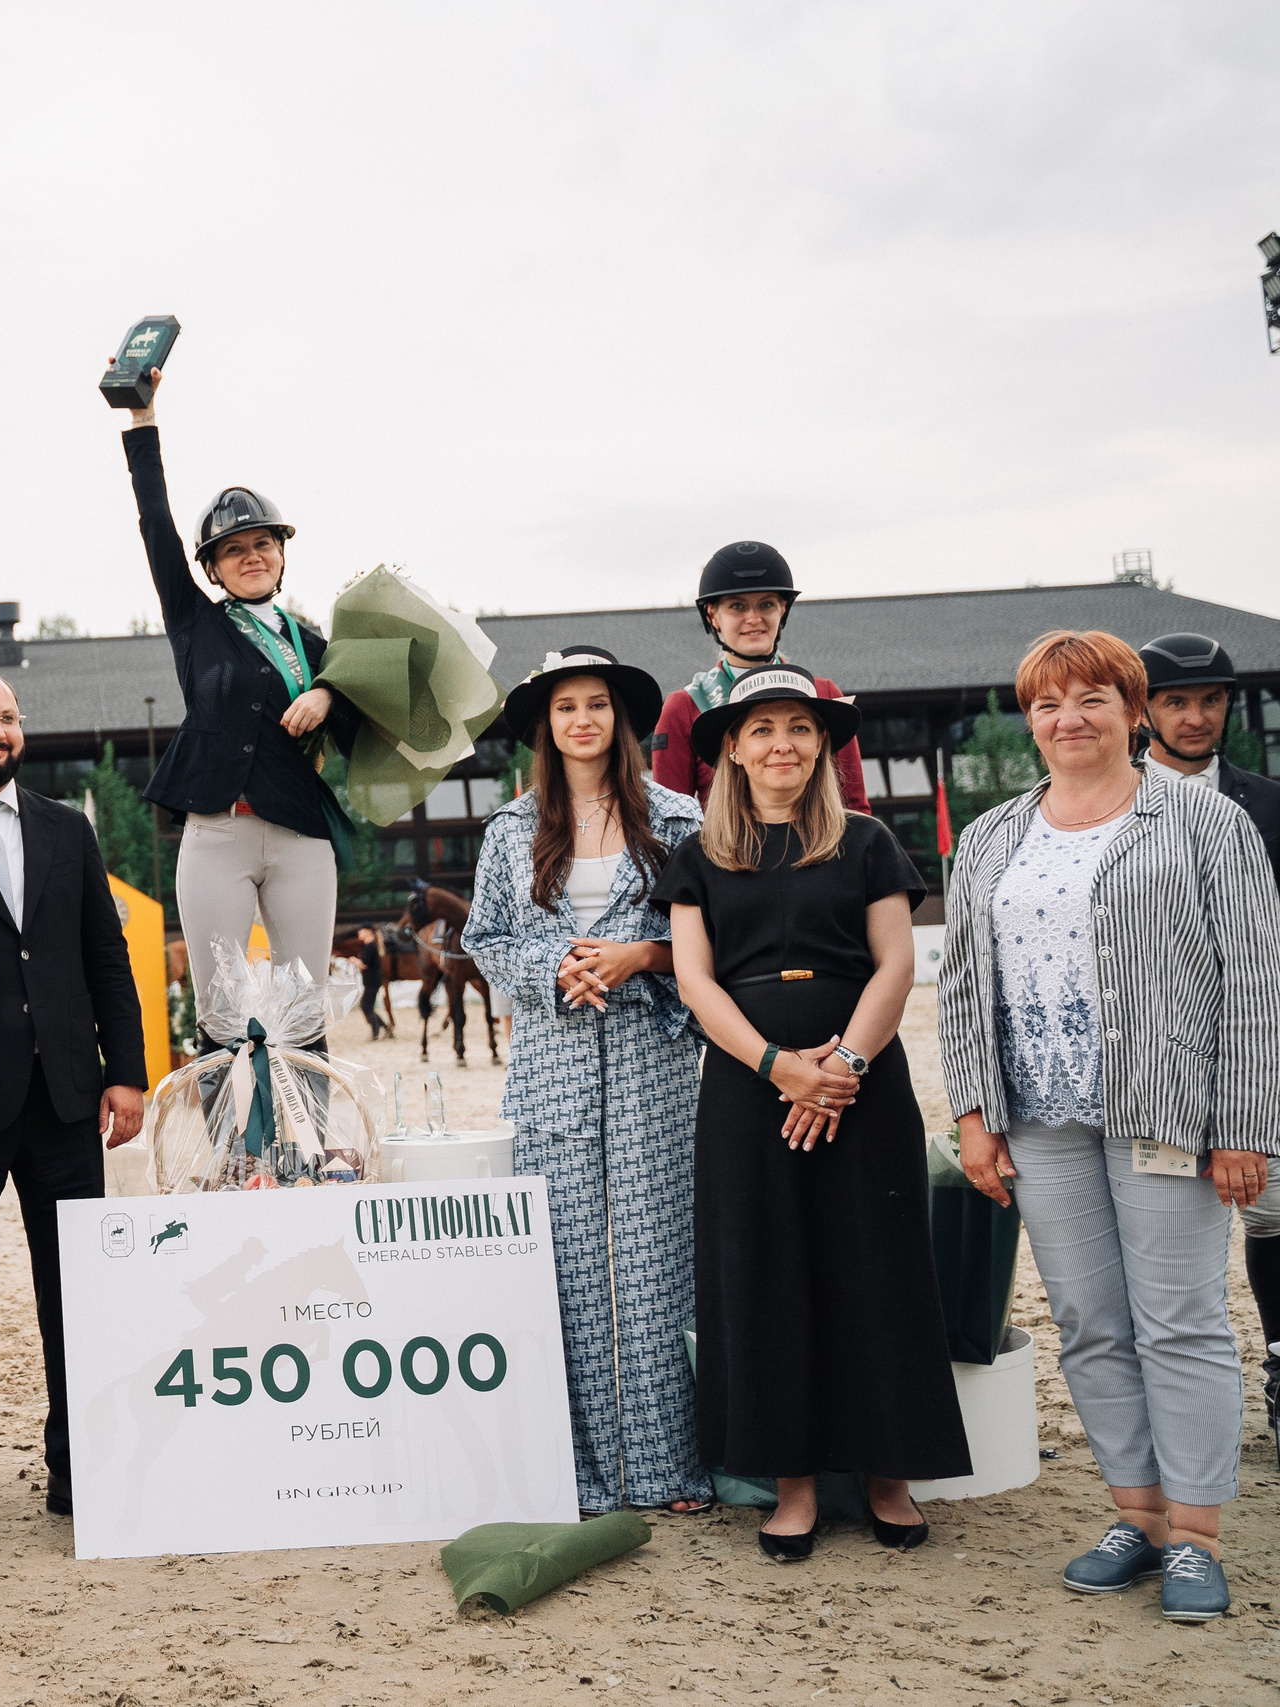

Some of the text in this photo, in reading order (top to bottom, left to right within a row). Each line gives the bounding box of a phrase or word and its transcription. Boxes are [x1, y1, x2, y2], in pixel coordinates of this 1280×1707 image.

[738, 676, 766, 697] EMERALD
[768, 674, 799, 686] STABLES
[270, 1056, 306, 1124] EMERALD STABLES CUP
[1139, 1143, 1159, 1151] EMERALD
[354, 1192, 536, 1244] СЕРТИФИКАТ
[357, 1242, 538, 1263] EMERALD STABLES CUP
[280, 1301, 372, 1321] 1 МЕСТО
[154, 1332, 508, 1407] 450 000
[291, 1417, 381, 1442] РУБЛЕЙ
[277, 1483, 403, 1500] BN GROUP
